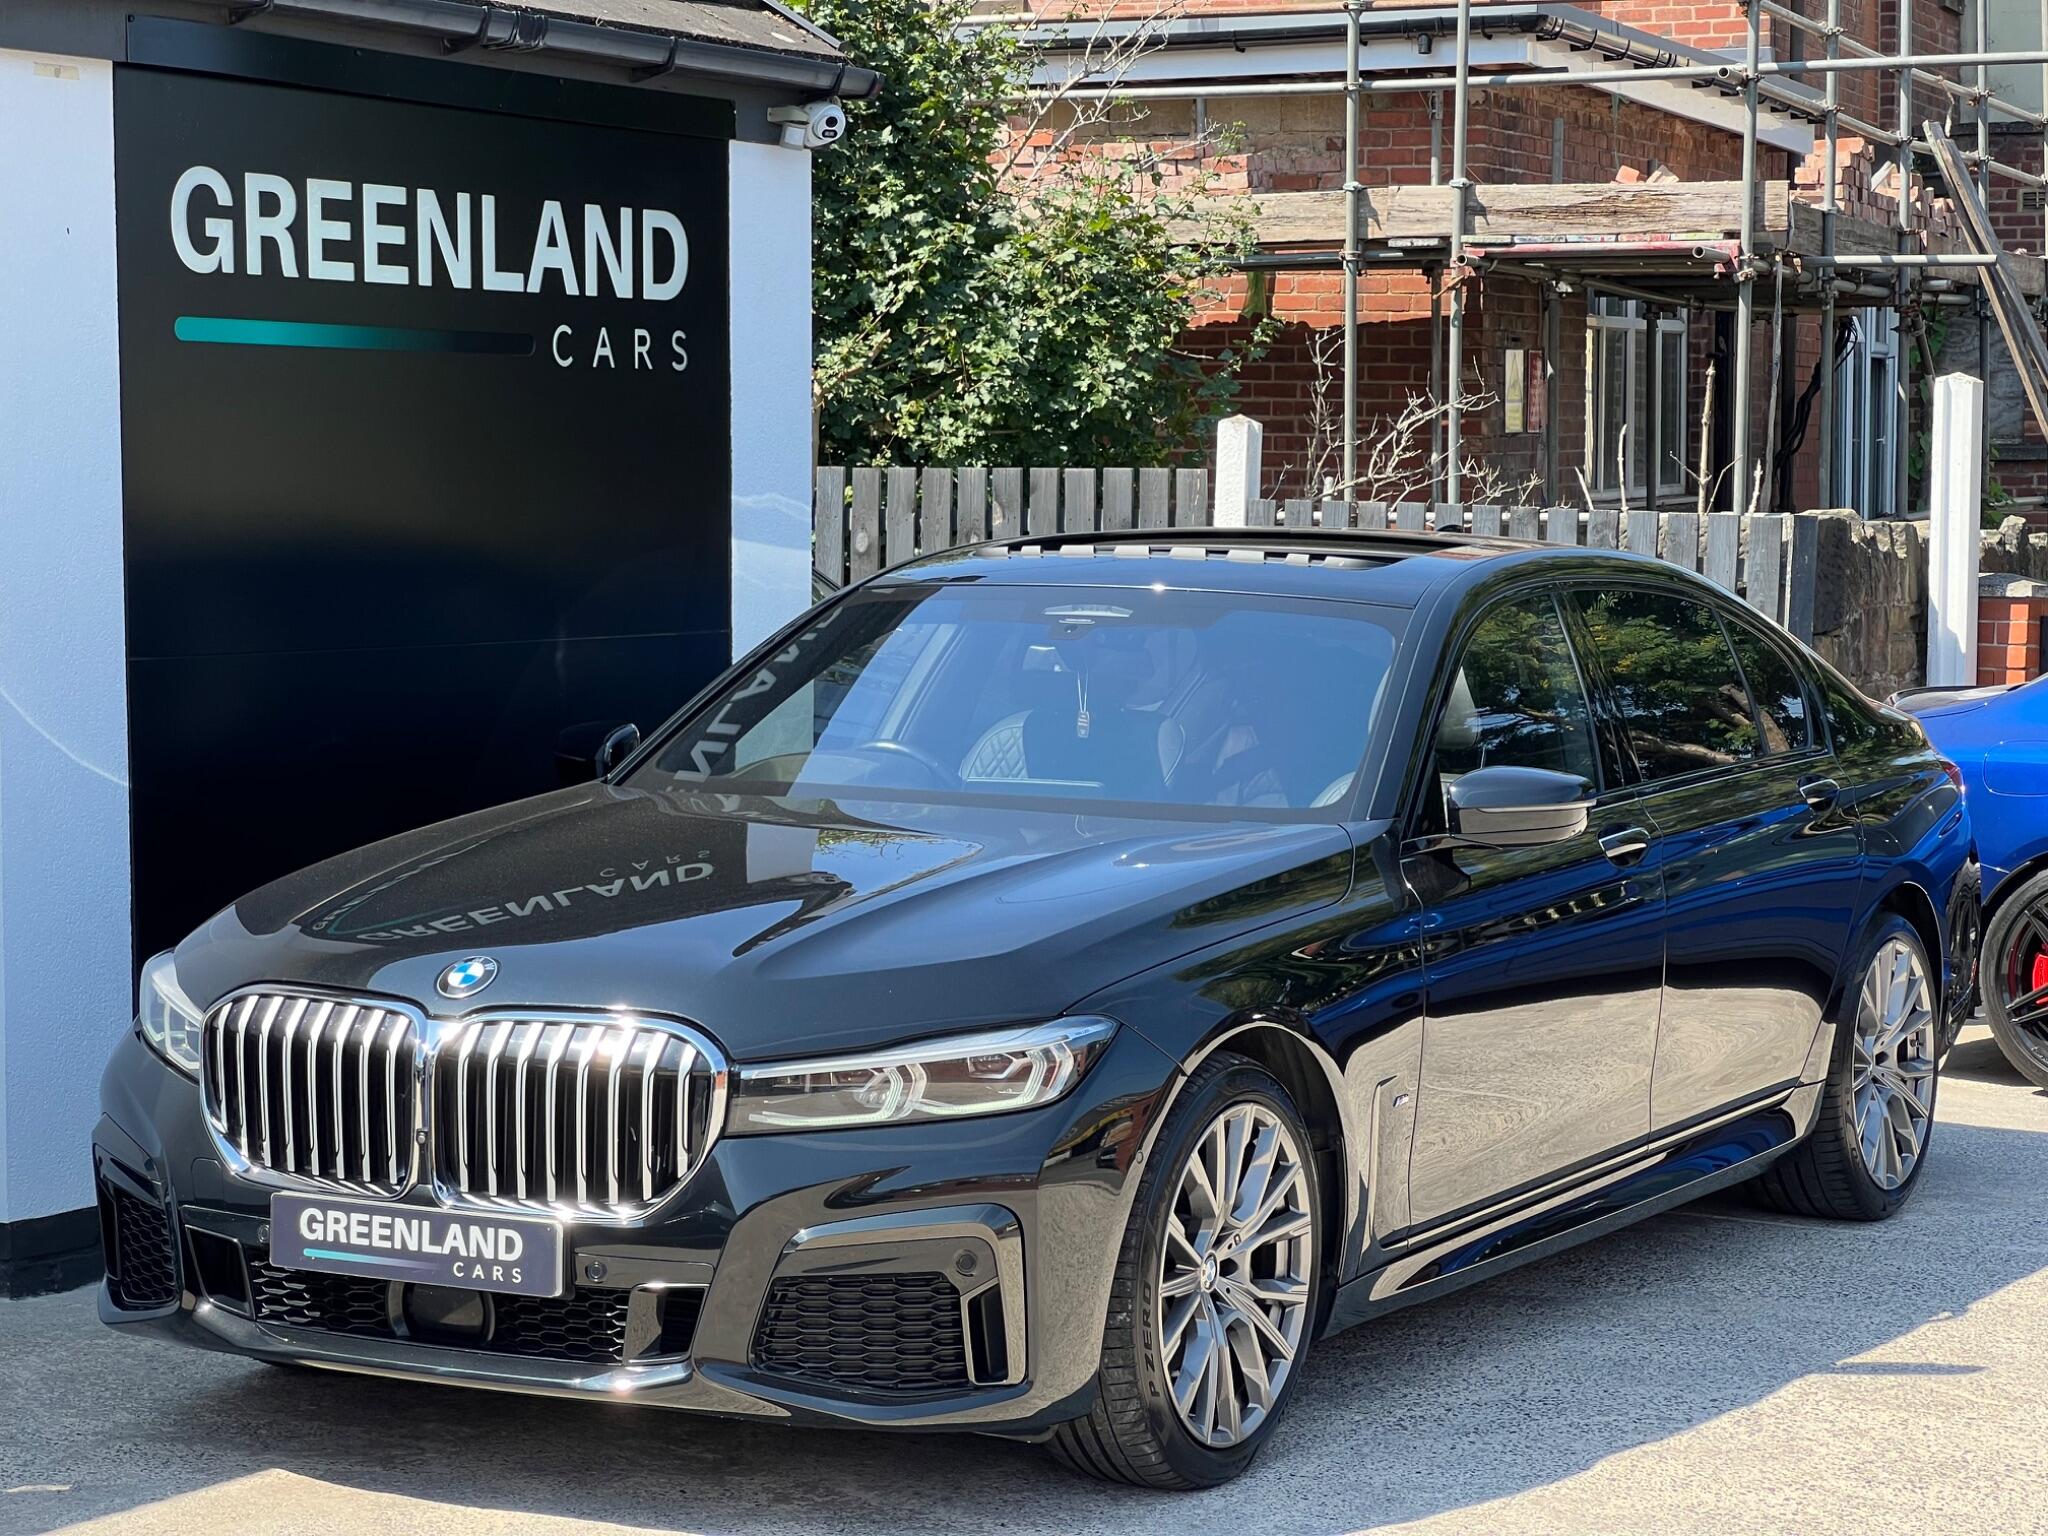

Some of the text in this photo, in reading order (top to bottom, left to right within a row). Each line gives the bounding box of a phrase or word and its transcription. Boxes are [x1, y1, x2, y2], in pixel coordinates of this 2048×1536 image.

[171, 166, 689, 301] GREENLAND
[553, 324, 688, 371] CARS
[300, 1207, 523, 1262] GREENLAND
[453, 1261, 522, 1283] CARS
[1142, 1281, 1160, 1397] P ZERO
